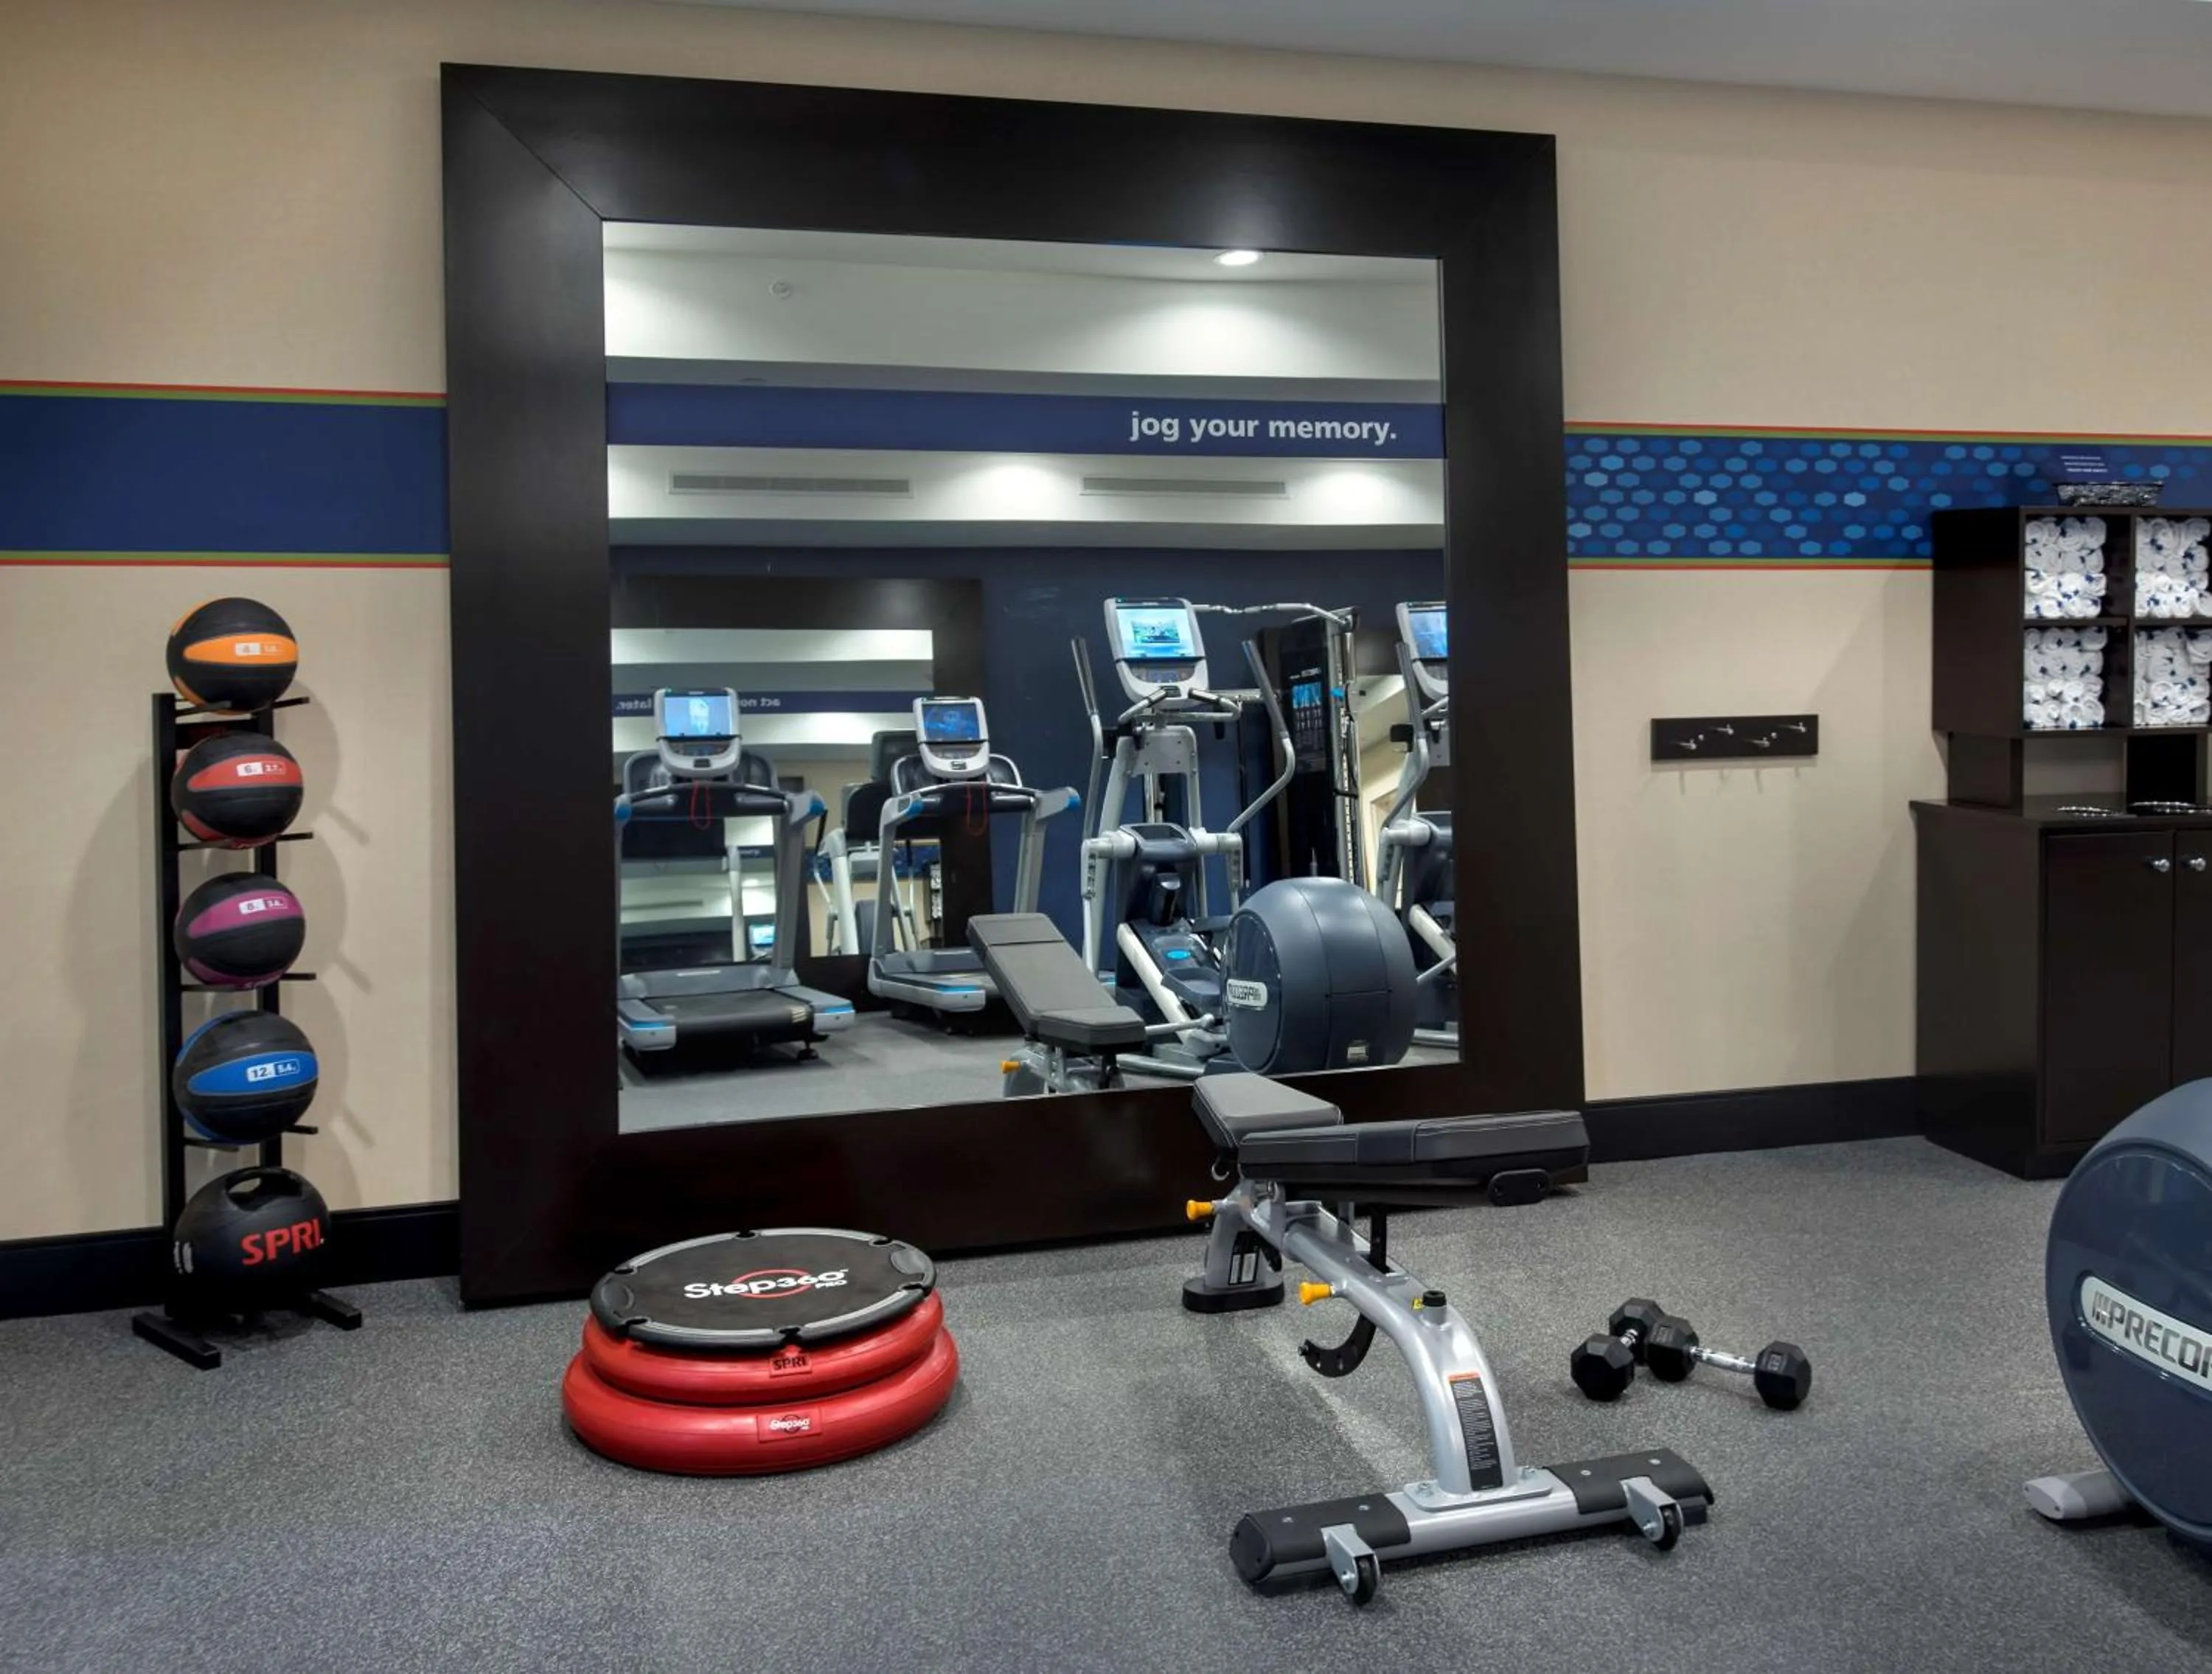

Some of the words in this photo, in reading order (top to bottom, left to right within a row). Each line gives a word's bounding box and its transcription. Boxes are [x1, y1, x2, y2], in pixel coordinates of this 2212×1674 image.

[1130, 411, 1180, 442] jog
[1189, 417, 1259, 442] your
[1268, 419, 1397, 445] memory.
[251, 1066, 268, 1079] 12
[241, 1218, 321, 1265] SPRI
[773, 1356, 807, 1371] SPRI
